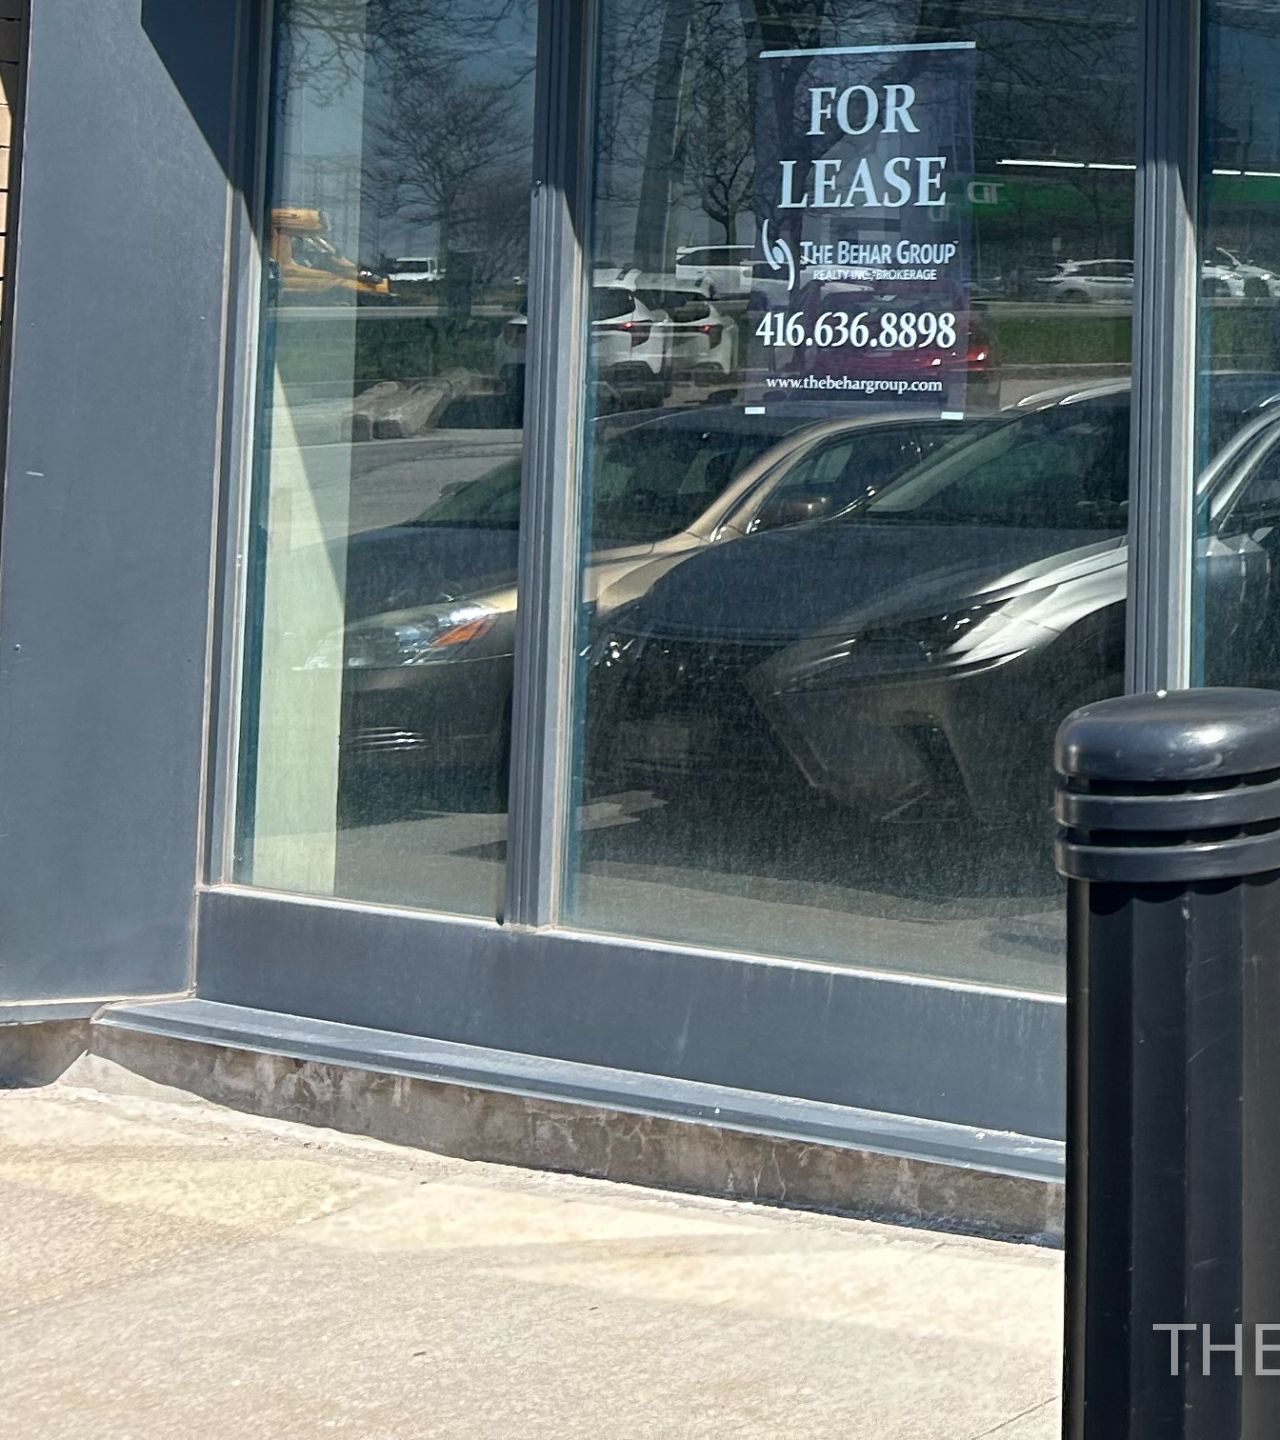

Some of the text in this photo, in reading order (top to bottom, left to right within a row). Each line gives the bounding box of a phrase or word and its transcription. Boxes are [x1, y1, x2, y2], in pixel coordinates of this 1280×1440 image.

[806, 84, 920, 136] FOR
[777, 156, 947, 209] LEASE
[813, 268, 849, 281] REALTY
[874, 268, 938, 281] BROKERAGE
[756, 311, 957, 348] 416.636.8898
[766, 376, 943, 394] www.thebehargroup.com
